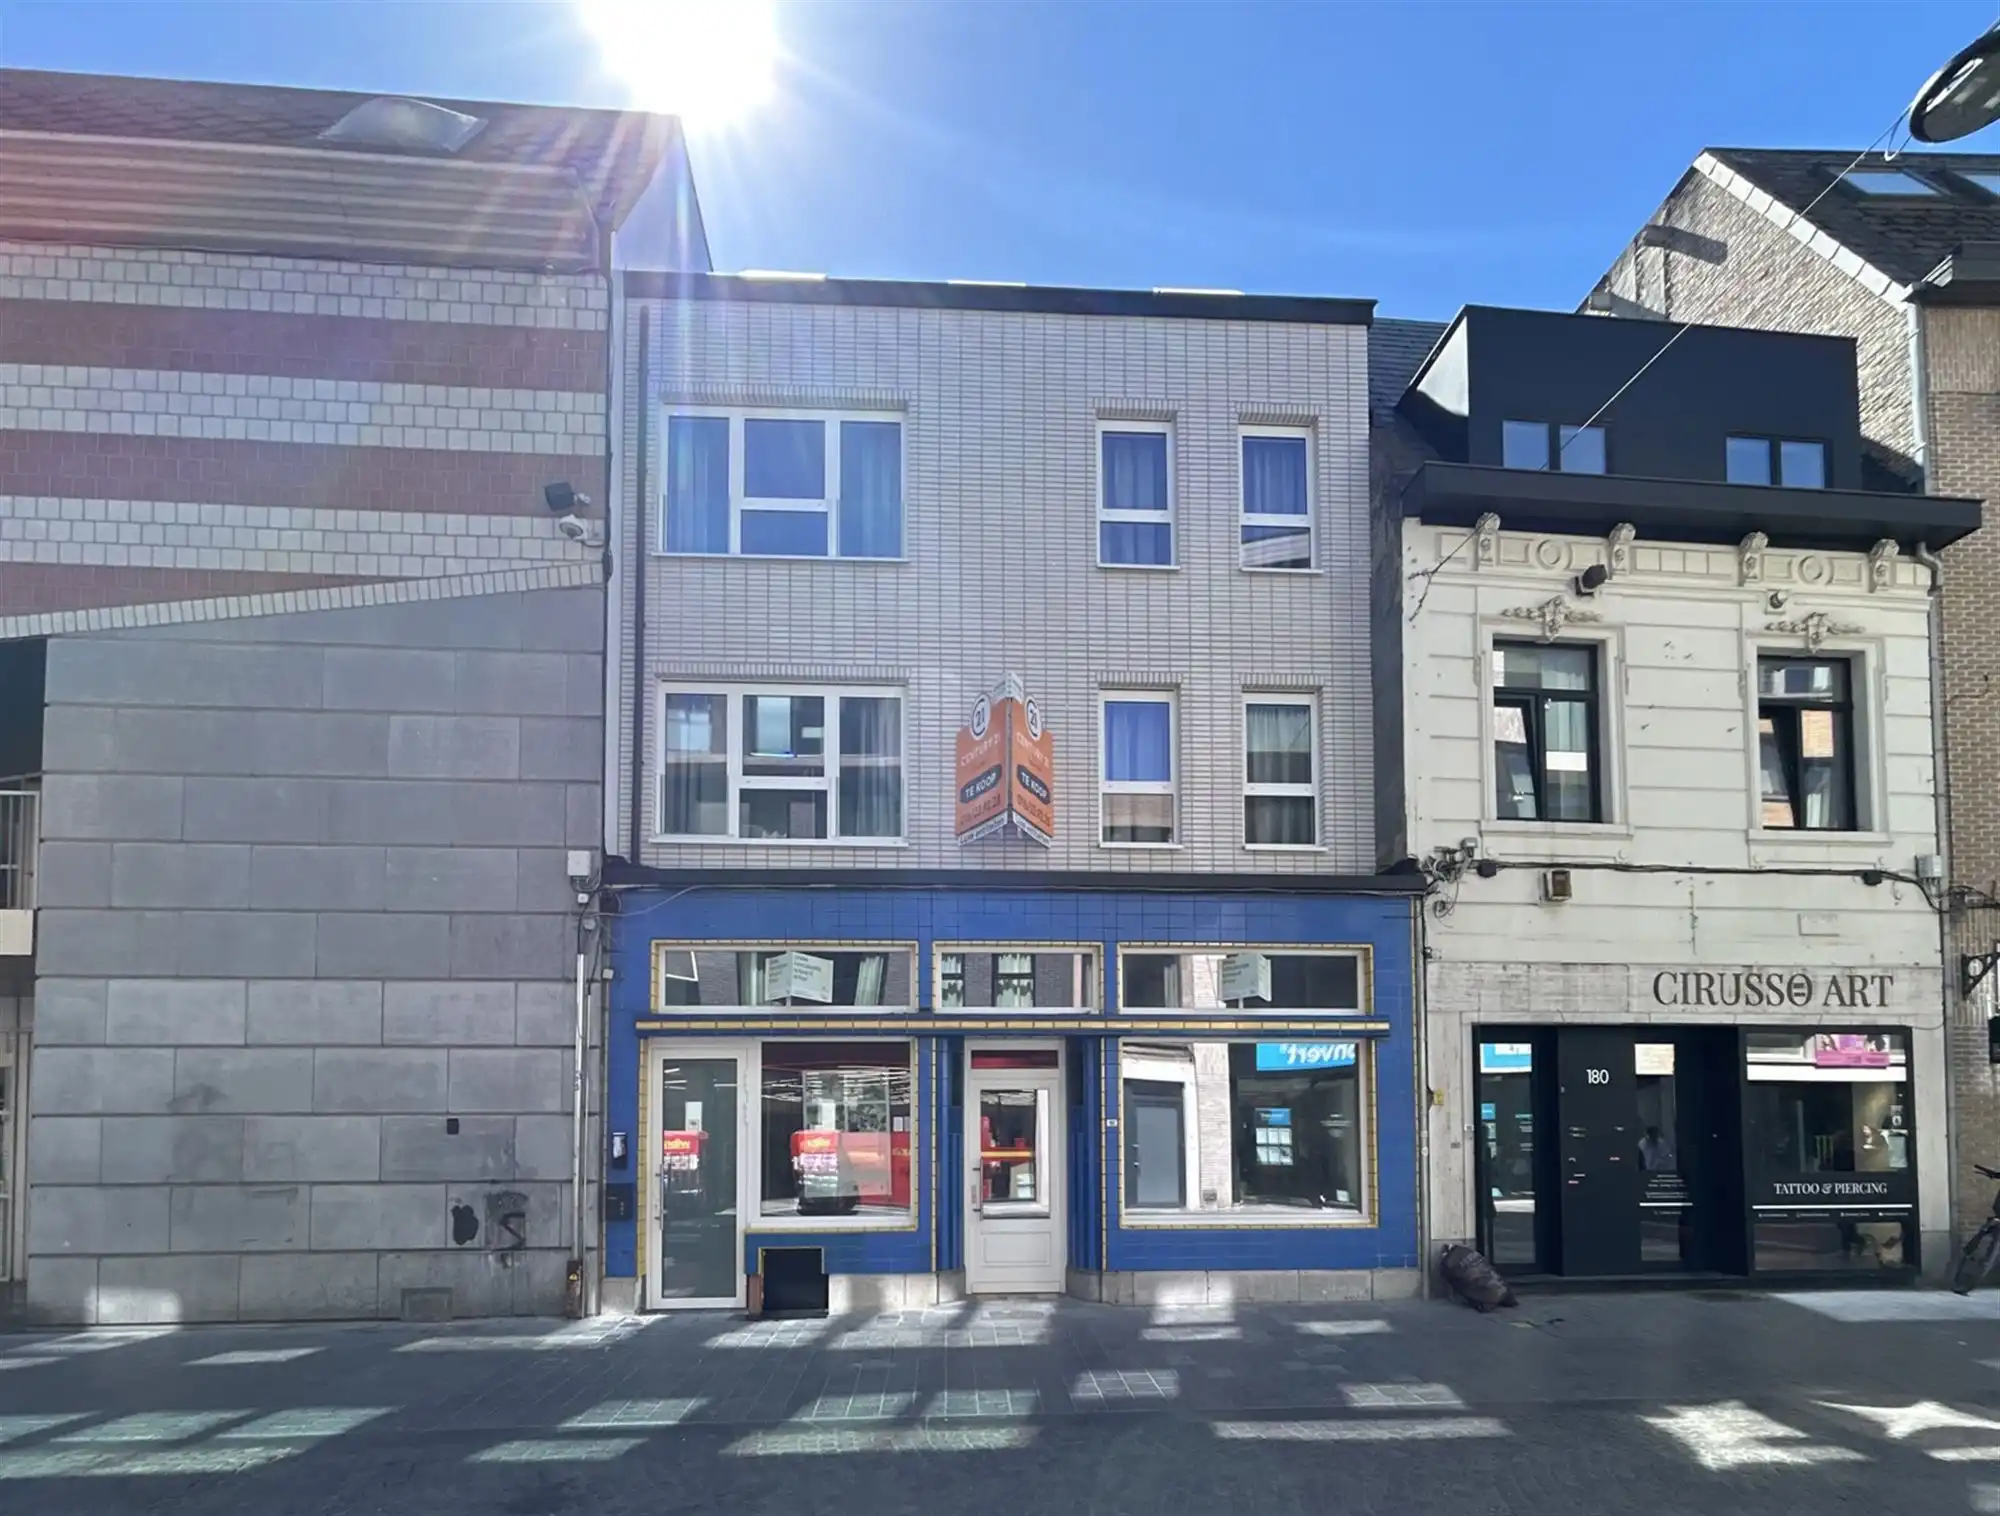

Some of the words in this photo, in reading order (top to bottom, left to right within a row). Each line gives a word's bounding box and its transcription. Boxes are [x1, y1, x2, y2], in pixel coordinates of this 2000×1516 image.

[964, 784, 976, 799] TE
[976, 771, 998, 794] KOOP
[1020, 771, 1031, 787] TE
[1030, 777, 1049, 799] KOOP
[1822, 974, 1894, 1007] ART
[1586, 1068, 1610, 1085] 180
[1773, 1183, 1820, 1195] TATTOO
[1821, 1183, 1833, 1195] &
[1834, 1182, 1888, 1195] PIERCING
